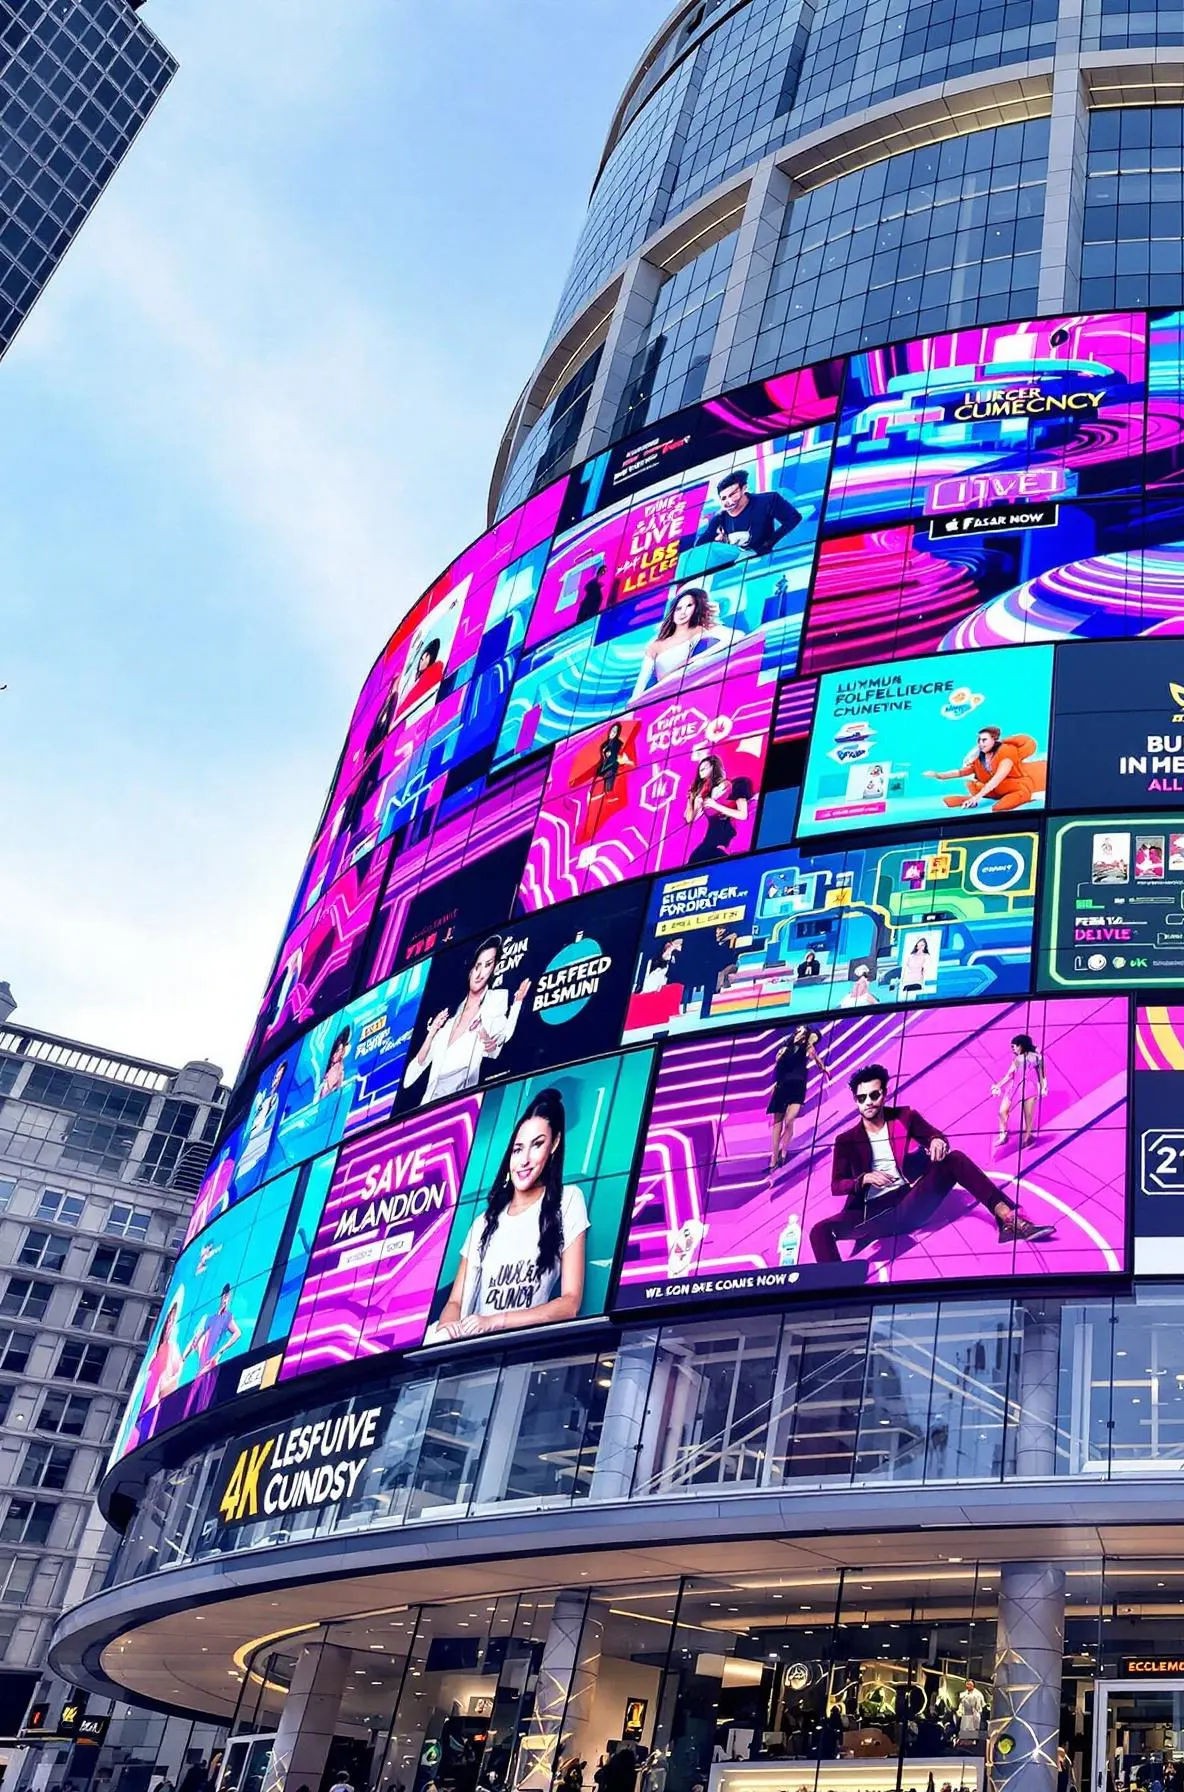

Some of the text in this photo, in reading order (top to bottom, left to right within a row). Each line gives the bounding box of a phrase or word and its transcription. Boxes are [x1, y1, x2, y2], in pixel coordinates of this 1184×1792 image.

[630, 516, 685, 556] LIVE
[1009, 513, 1044, 524] NOW
[361, 1143, 433, 1201] SAVE
[756, 1273, 787, 1286] NOW
[219, 1438, 275, 1522] 4K
